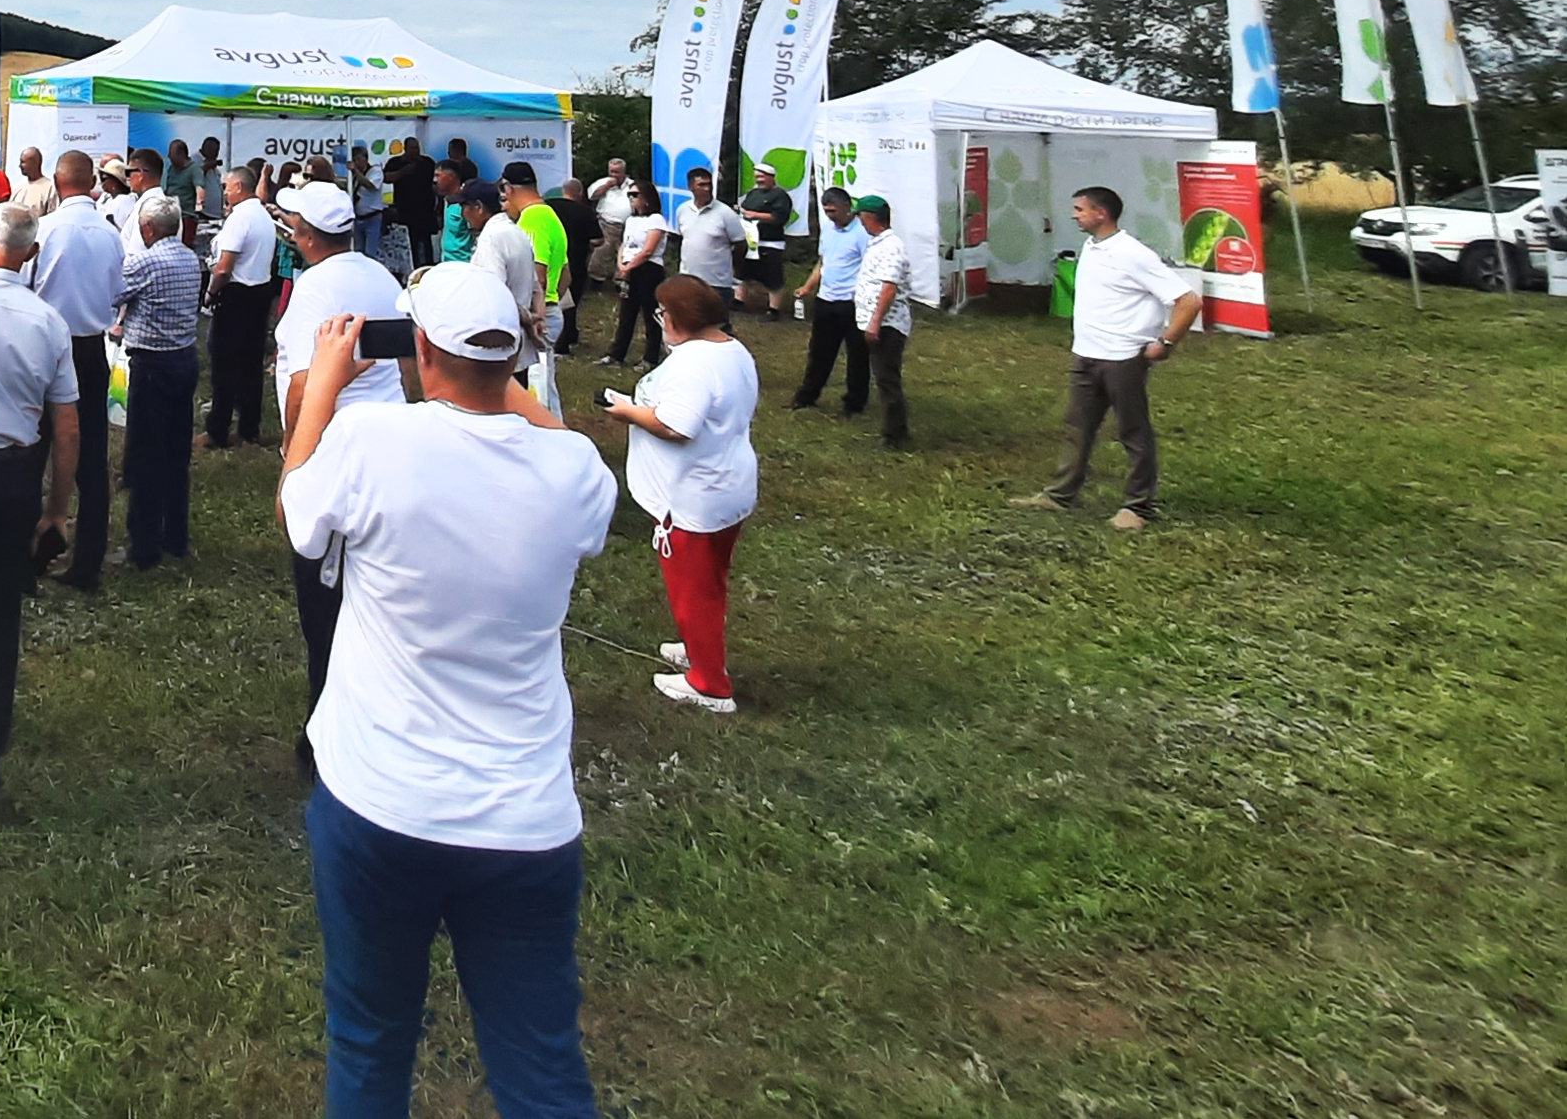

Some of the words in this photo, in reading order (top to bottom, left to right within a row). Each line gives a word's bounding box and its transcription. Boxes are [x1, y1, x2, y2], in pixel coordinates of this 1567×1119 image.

[214, 47, 336, 69] avgust
[292, 68, 335, 77] crop
[679, 39, 701, 108] avgust
[771, 41, 795, 110] avgust
[256, 87, 272, 105] С
[276, 94, 327, 107] нами
[330, 94, 384, 110] расти
[386, 94, 441, 109] легче
[264, 134, 346, 162] avgust
[496, 136, 531, 152] avgust
